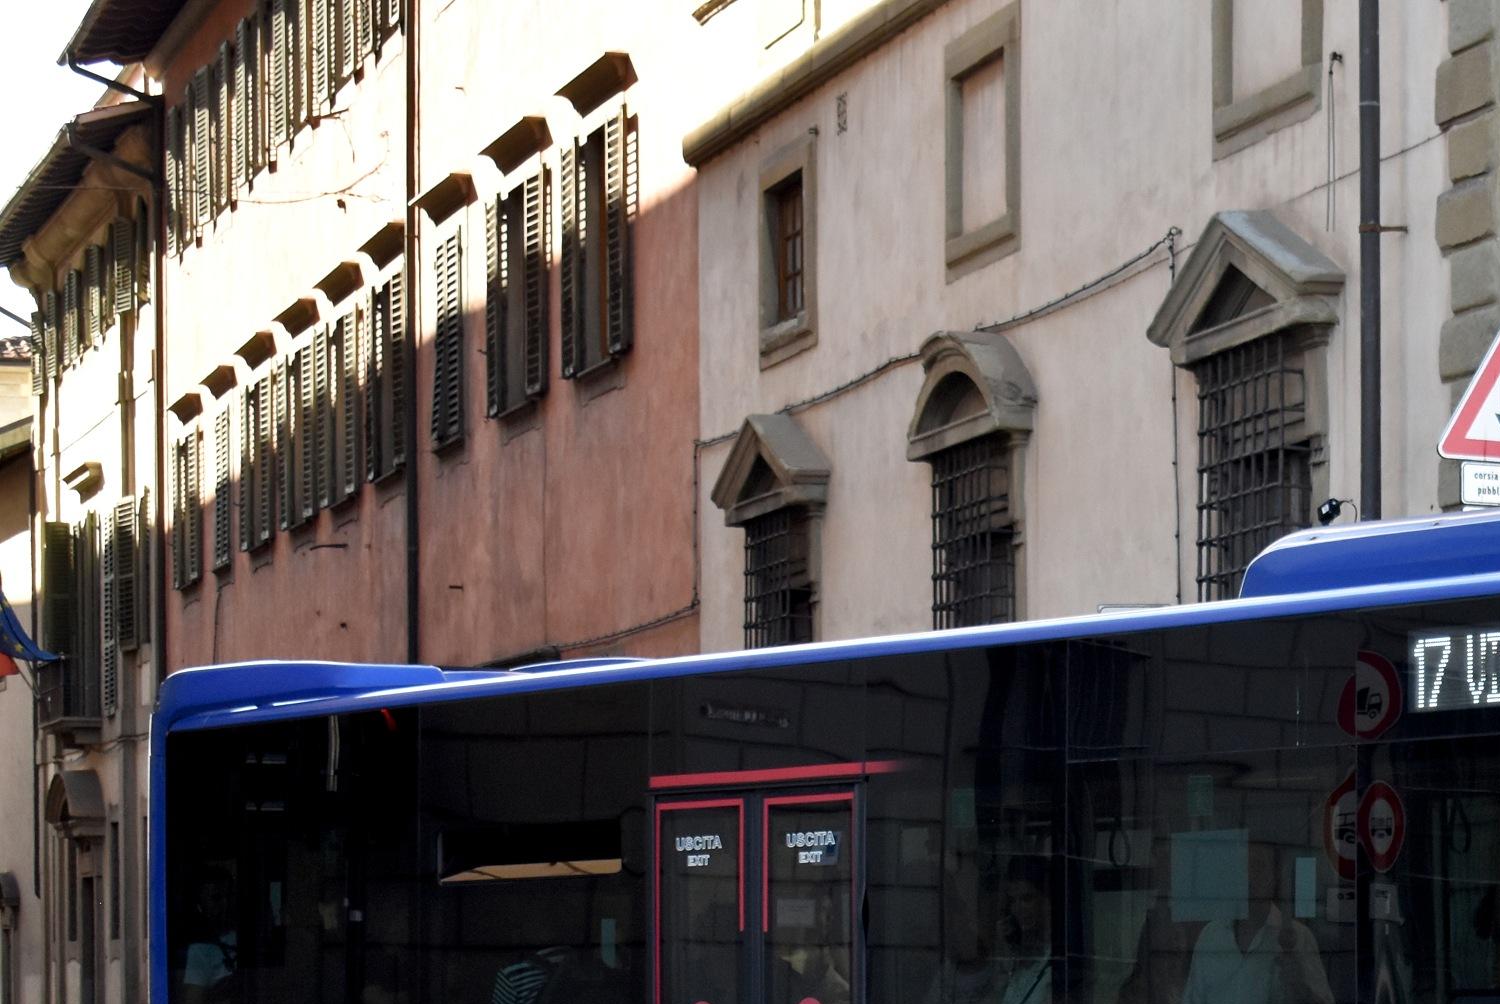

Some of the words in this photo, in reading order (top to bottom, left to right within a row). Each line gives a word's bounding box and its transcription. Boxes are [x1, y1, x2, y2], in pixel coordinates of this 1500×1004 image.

[1474, 472, 1498, 480] corsia
[1414, 637, 1451, 709] 17
[675, 835, 722, 851] USCITA
[786, 831, 835, 848] USCITA
[687, 854, 710, 867] EXIT
[798, 851, 823, 864] EXIT
